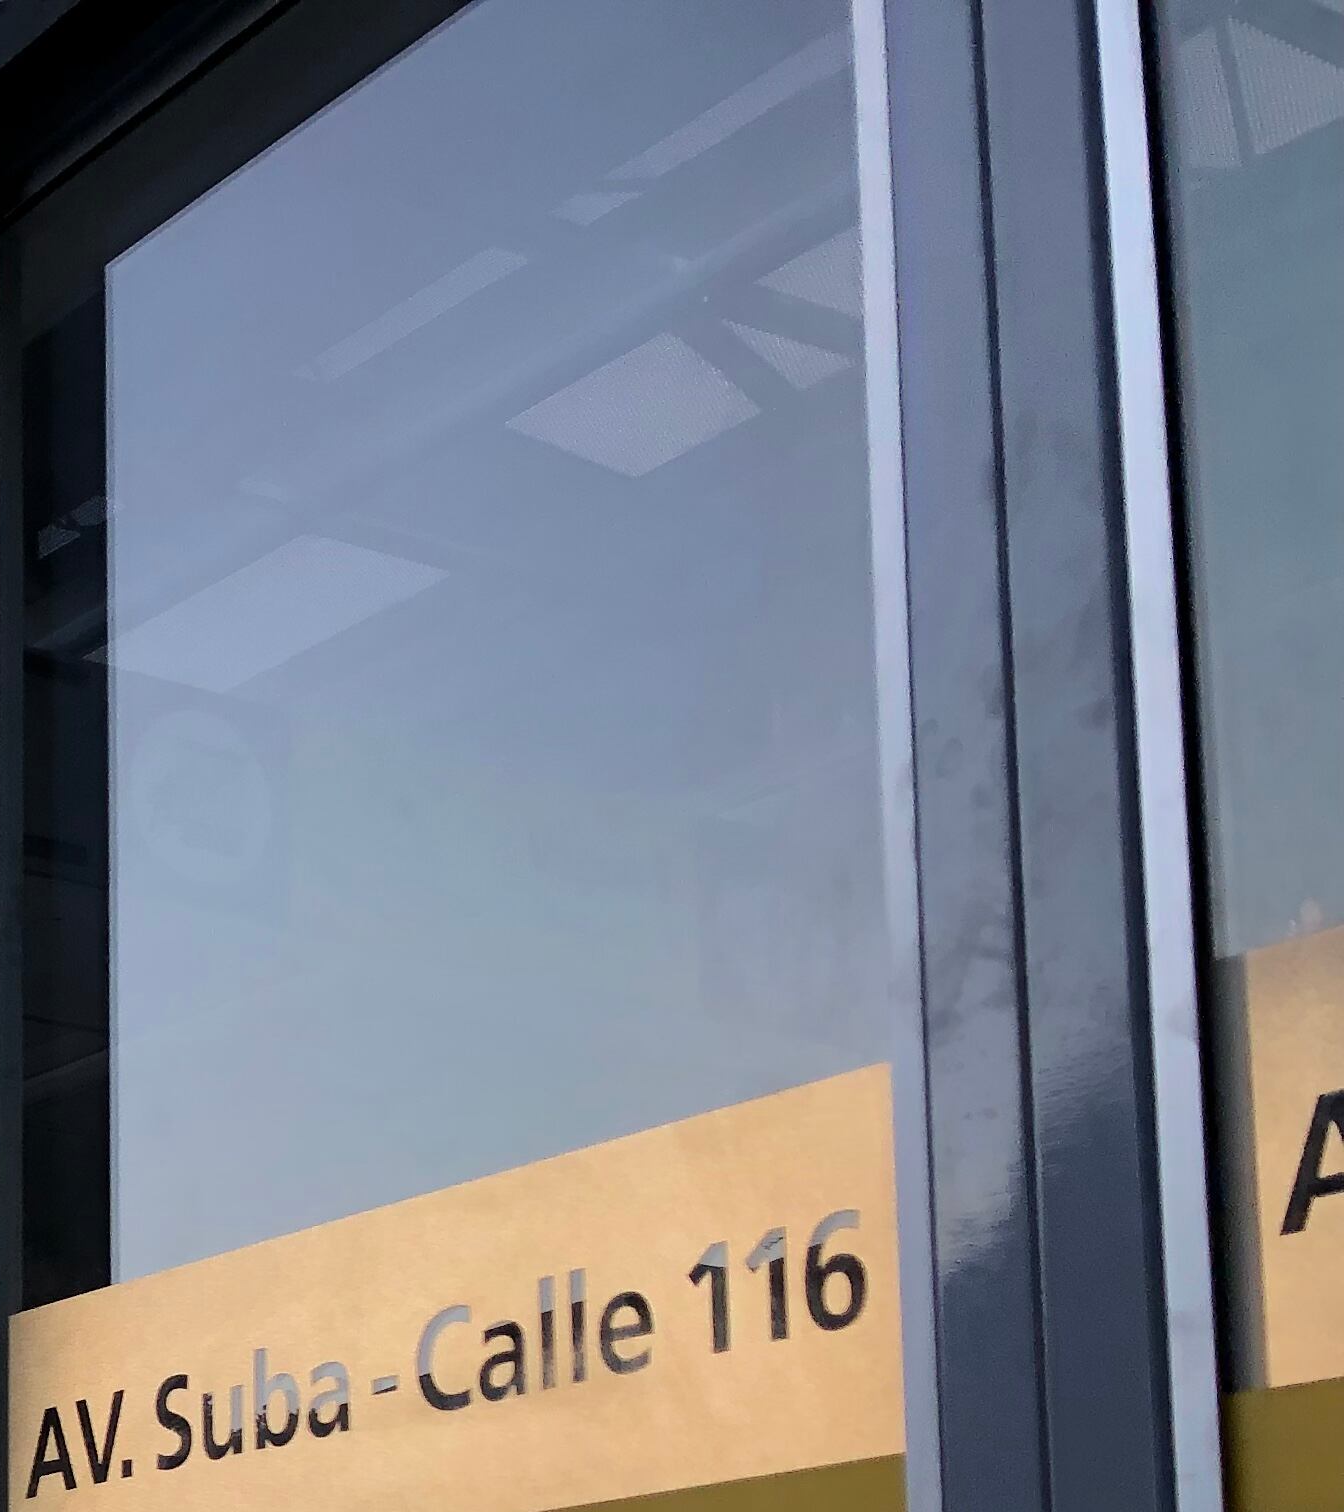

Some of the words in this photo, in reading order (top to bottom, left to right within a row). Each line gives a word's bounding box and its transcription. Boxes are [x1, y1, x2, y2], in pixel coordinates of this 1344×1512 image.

[25, 1388, 134, 1500] AV.
[154, 1347, 353, 1471] Suba
[416, 1267, 655, 1412] Calle
[687, 1207, 869, 1354] 116
